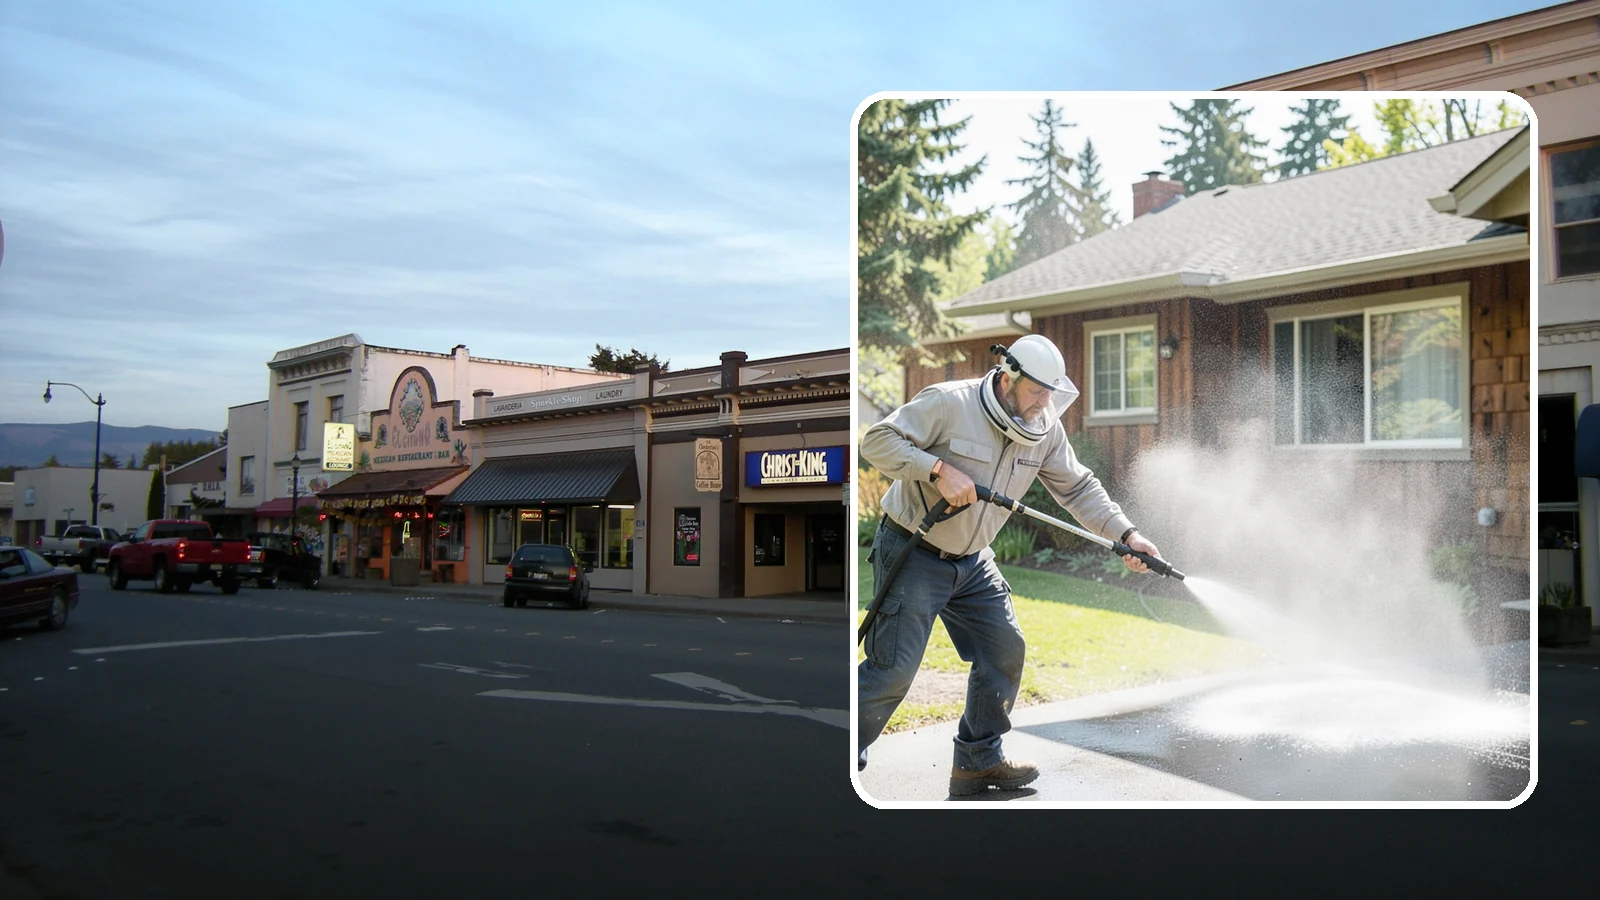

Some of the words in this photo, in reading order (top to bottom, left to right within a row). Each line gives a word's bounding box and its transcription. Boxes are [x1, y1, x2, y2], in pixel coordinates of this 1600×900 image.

[493, 402, 522, 412] LAVANDERIA
[531, 398, 561, 409] Sparkle
[561, 394, 582, 405] Shop
[595, 389, 623, 400] LAUNDRY
[373, 454, 396, 464] MEXICAN
[397, 451, 434, 462] RESTAURANT
[438, 450, 450, 459] BAR
[799, 450, 828, 476] KING
[696, 480, 709, 489] Coffee
[710, 480, 722, 489] House
